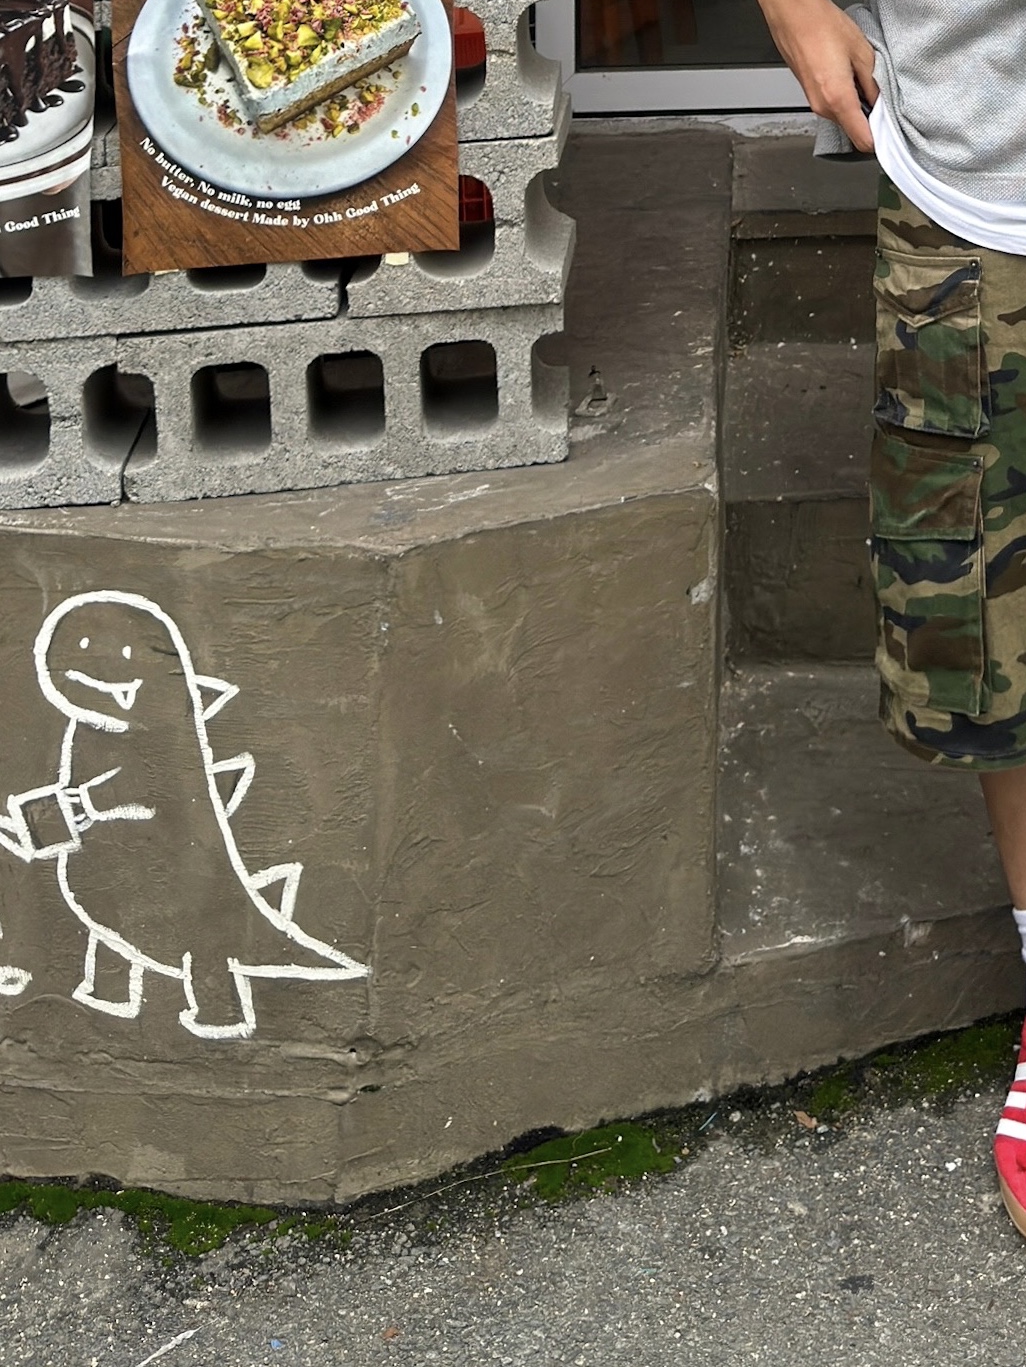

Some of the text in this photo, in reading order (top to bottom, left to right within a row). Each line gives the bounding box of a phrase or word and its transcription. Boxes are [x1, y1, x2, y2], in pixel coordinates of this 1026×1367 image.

[139, 136, 301, 212] No butter, No milk, no egg
[4, 206, 80, 233] Good Thing
[160, 175, 421, 229] Vegan dessert Made by Ohh Good Thing
